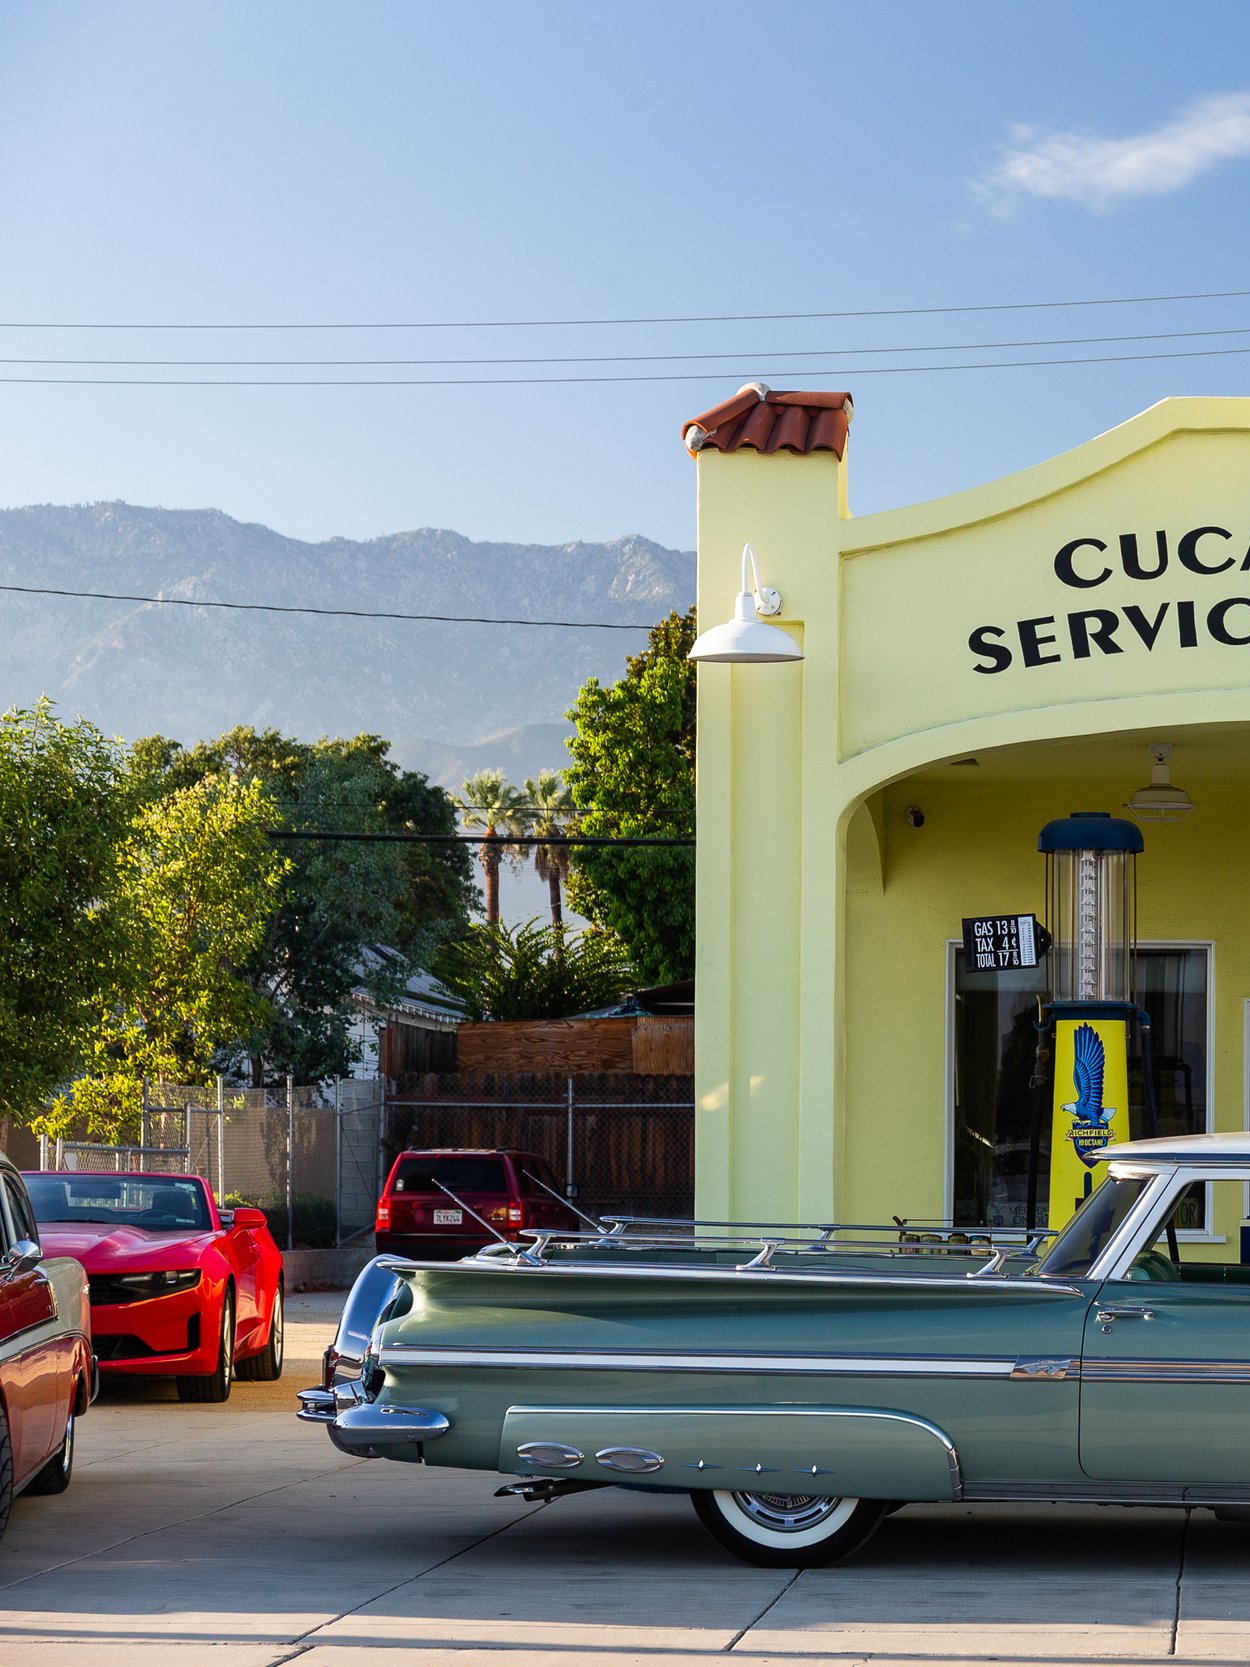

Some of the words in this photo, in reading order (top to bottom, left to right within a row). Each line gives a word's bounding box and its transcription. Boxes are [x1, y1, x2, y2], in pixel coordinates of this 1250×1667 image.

[974, 921, 994, 937] GAS
[995, 920, 1008, 935] 13
[975, 937, 995, 952] TAX
[1002, 936, 1010, 950] 4
[975, 952, 997, 968] TOTAL
[998, 952, 1010, 967] 17
